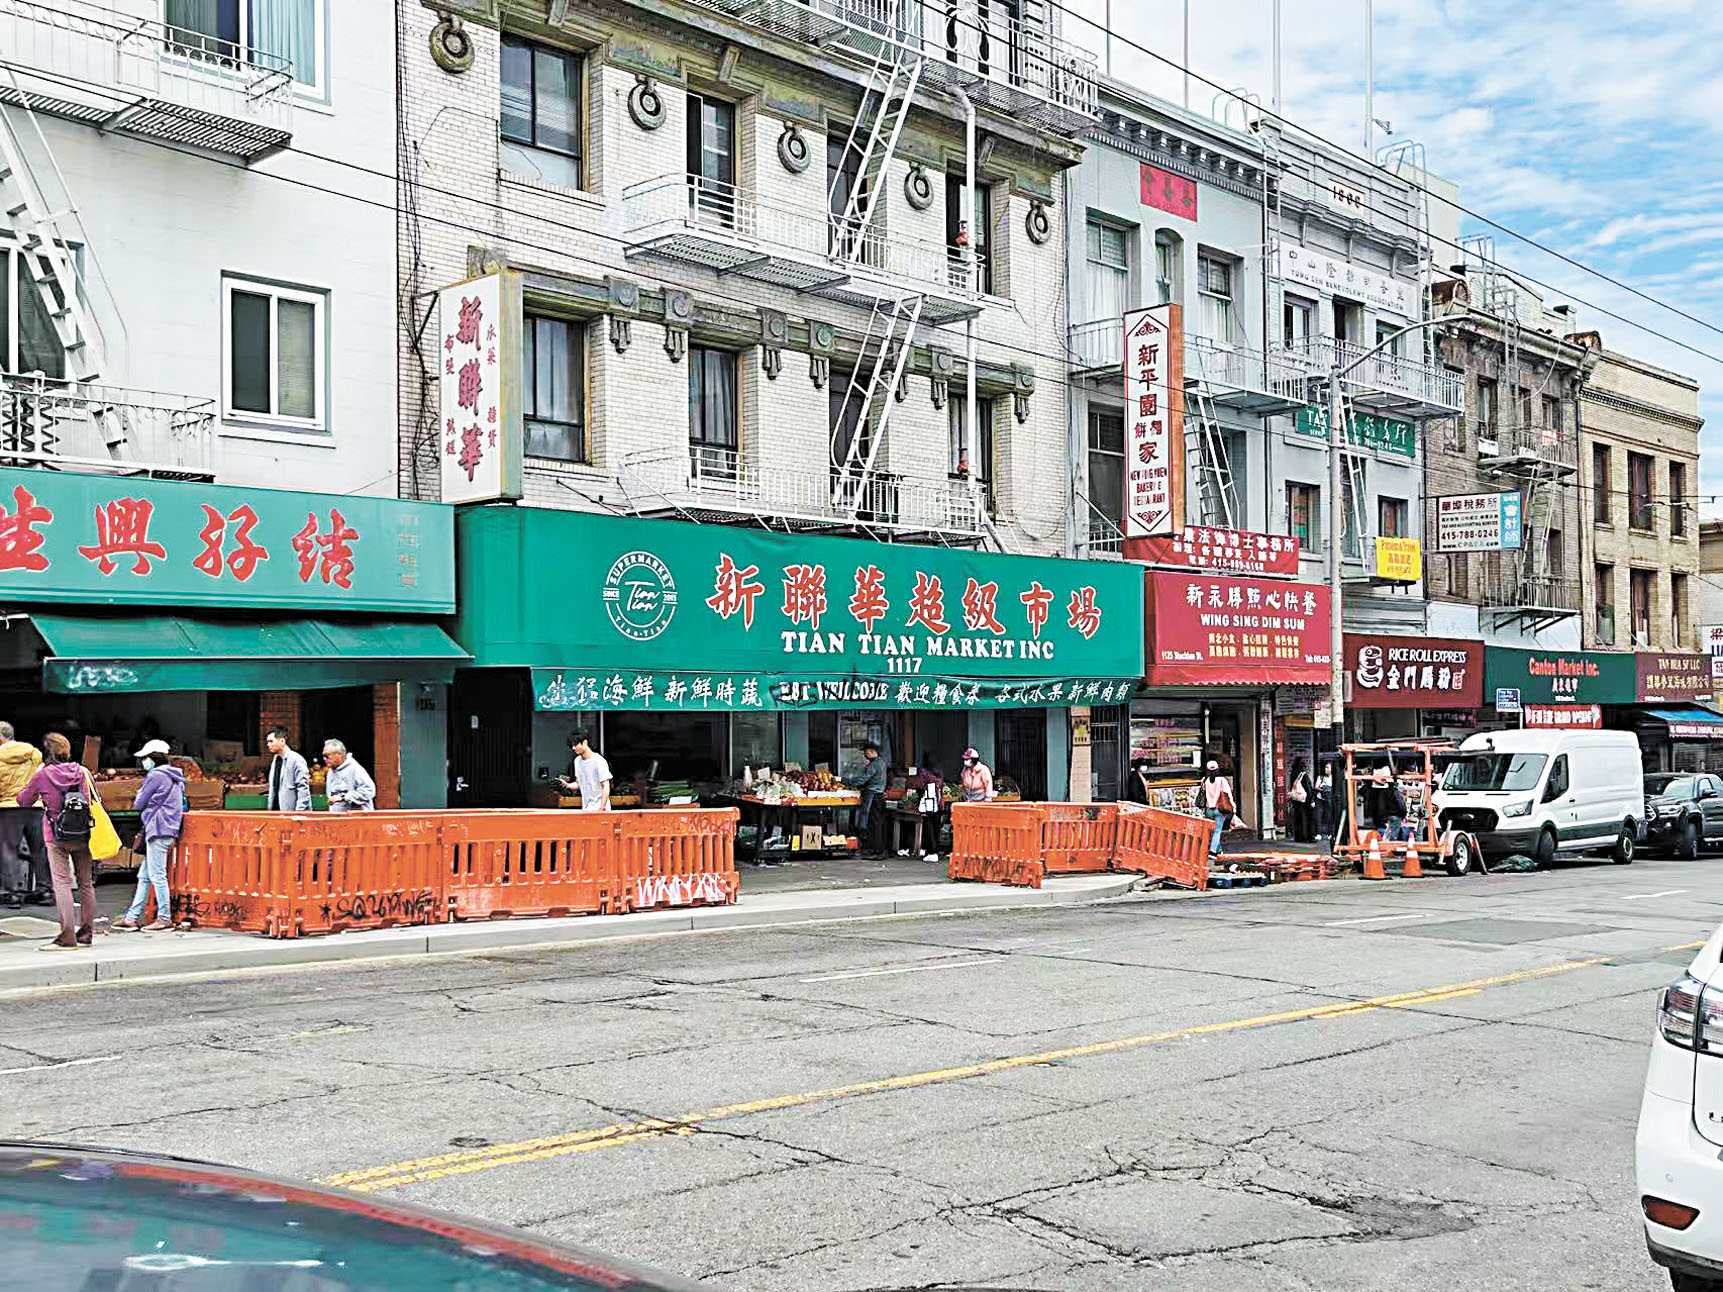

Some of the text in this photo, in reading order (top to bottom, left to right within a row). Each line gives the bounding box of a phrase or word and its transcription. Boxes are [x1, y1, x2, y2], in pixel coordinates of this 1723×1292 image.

[455, 296, 484, 483] 新聯華
[609, 554, 673, 588] SUPERMARKET
[705, 552, 1102, 641] 新聯華超級市場
[1201, 614, 1305, 630] WING SING DIM SUM
[780, 631, 1054, 660] TIAN TIAN MARKET INC
[1388, 648, 1467, 664] RICE ROLL EXPRESS
[887, 657, 923, 674] 1117
[1558, 658, 1584, 676] Market
